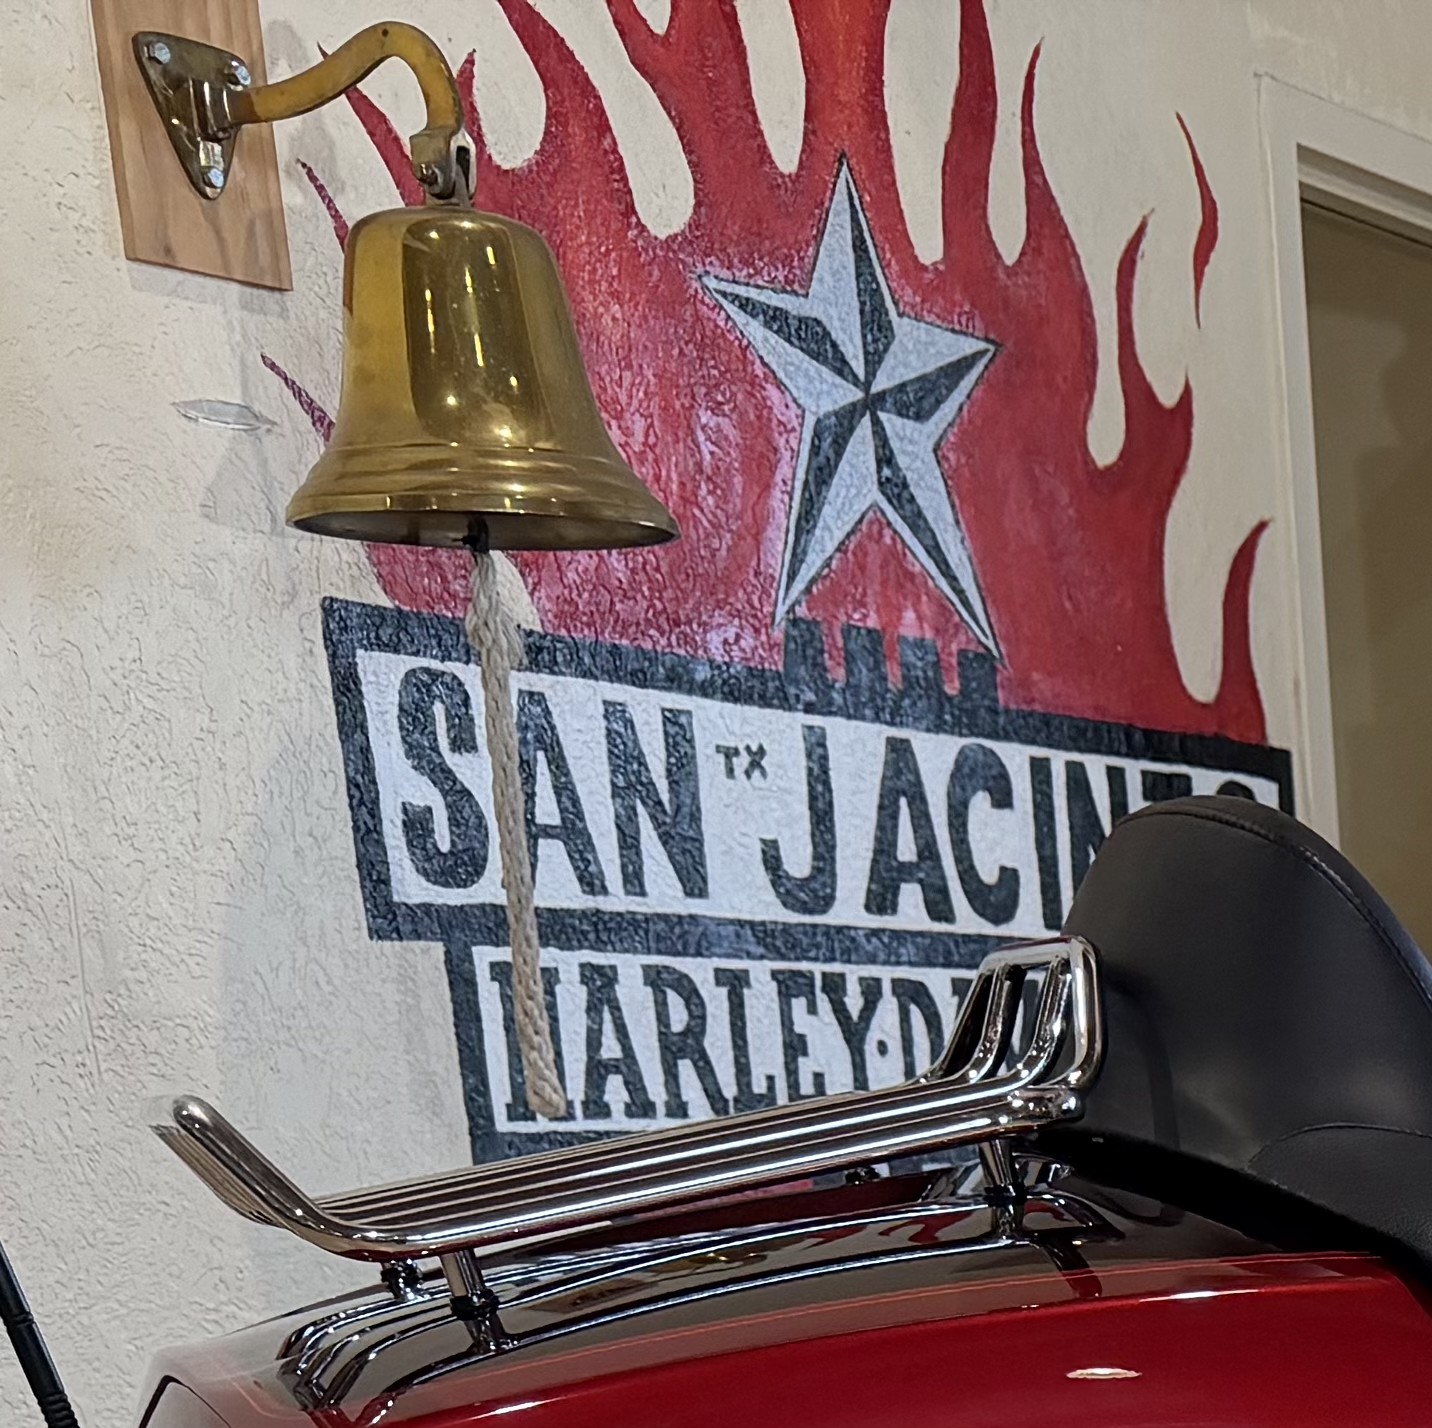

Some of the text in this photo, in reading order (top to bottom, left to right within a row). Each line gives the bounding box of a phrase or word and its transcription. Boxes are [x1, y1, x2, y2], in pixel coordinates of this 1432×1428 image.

[398, 666, 1257, 931] SAN JACIN
[715, 743, 768, 780] TX
